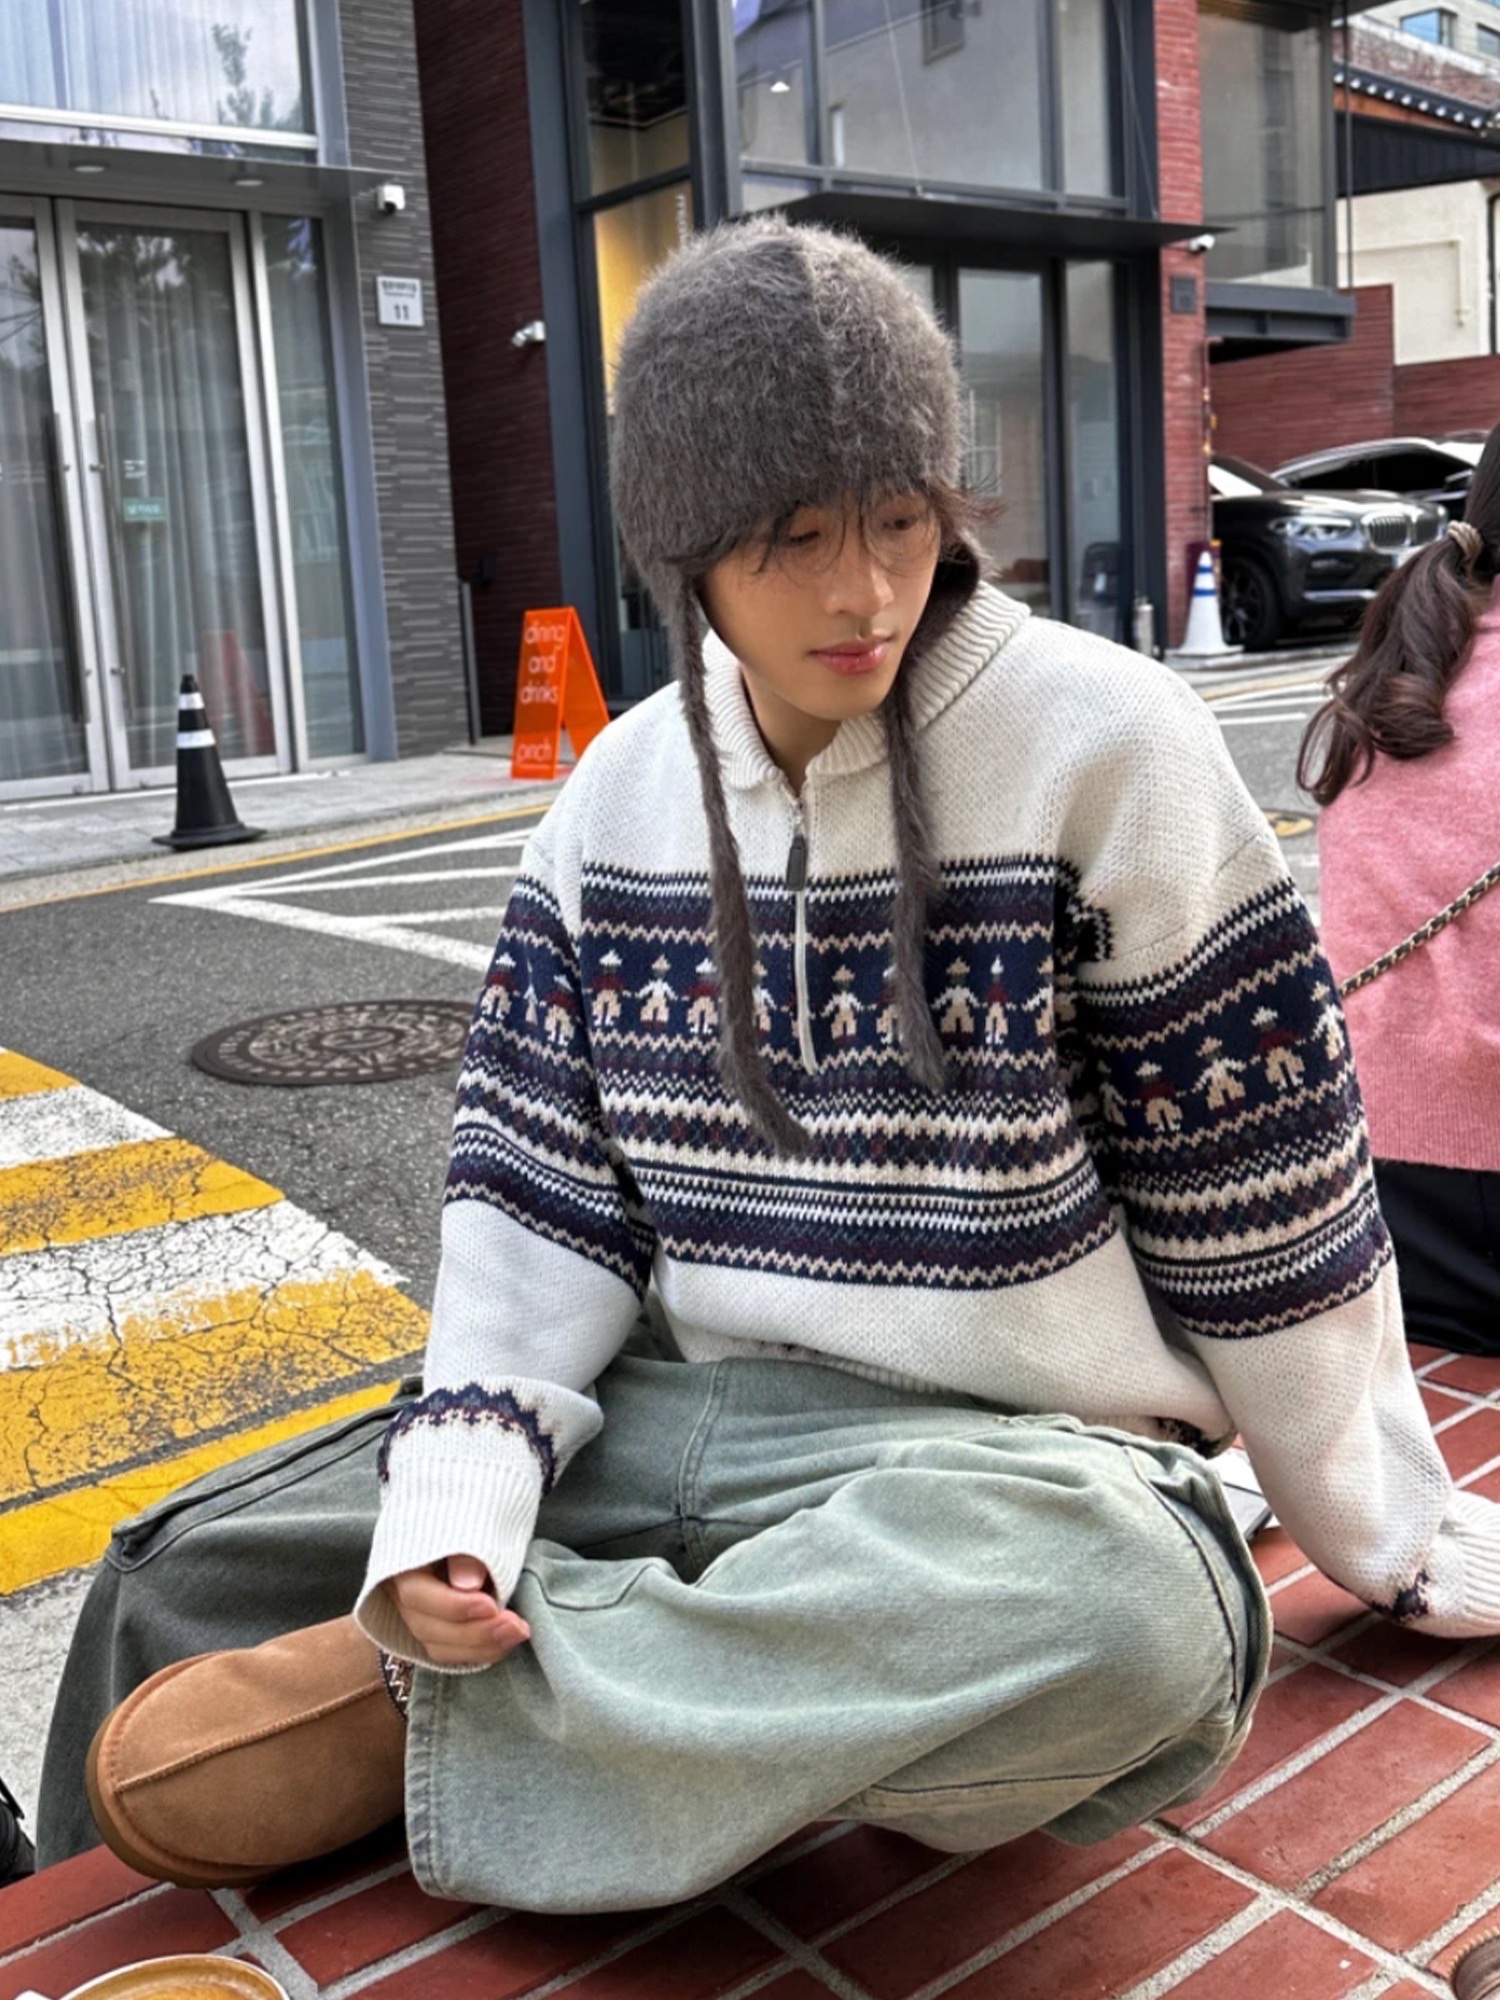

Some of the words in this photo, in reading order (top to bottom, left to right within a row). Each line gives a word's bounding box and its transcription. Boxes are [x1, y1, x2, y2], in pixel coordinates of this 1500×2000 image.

[394, 304, 409, 320] 11
[524, 620, 565, 650] dining
[528, 650, 556, 673] and
[520, 680, 558, 703] drinks
